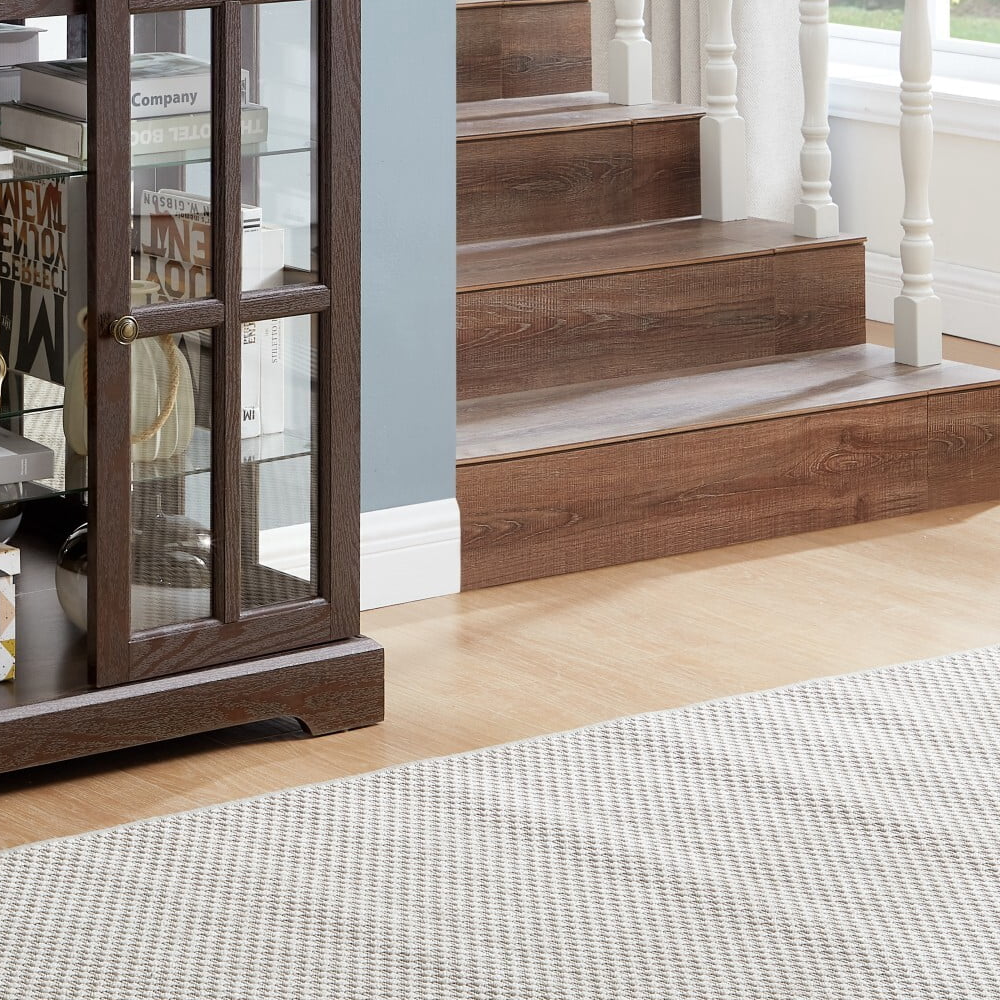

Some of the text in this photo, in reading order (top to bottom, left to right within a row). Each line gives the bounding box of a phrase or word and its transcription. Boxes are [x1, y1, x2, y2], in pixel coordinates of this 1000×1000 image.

[131, 91, 198, 109] Company
[167, 123, 211, 141] OTEL
[141, 214, 212, 268] ENT
